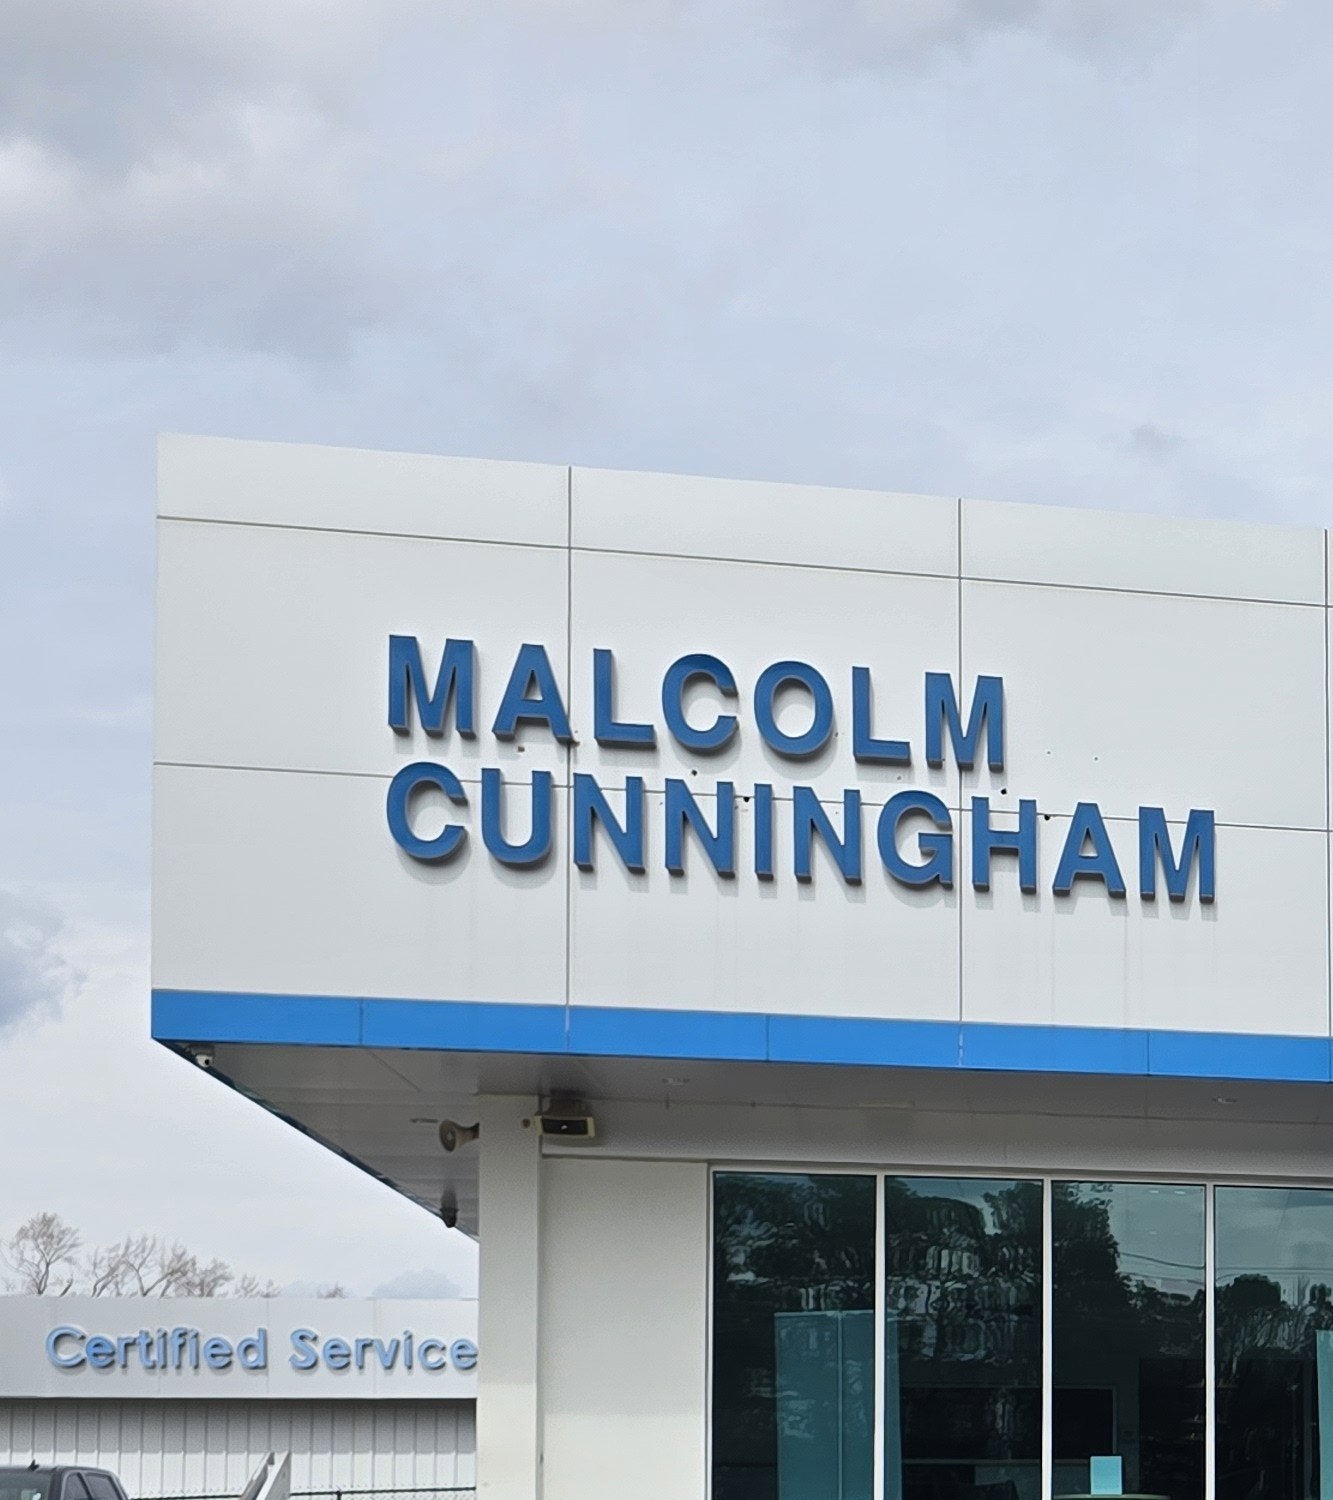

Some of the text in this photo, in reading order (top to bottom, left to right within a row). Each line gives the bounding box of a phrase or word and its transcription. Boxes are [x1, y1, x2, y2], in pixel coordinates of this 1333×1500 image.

[387, 633, 1006, 773] MALCOLM
[386, 760, 1216, 904] CUNNINGHAM
[45, 1325, 479, 1371] Certified Service
